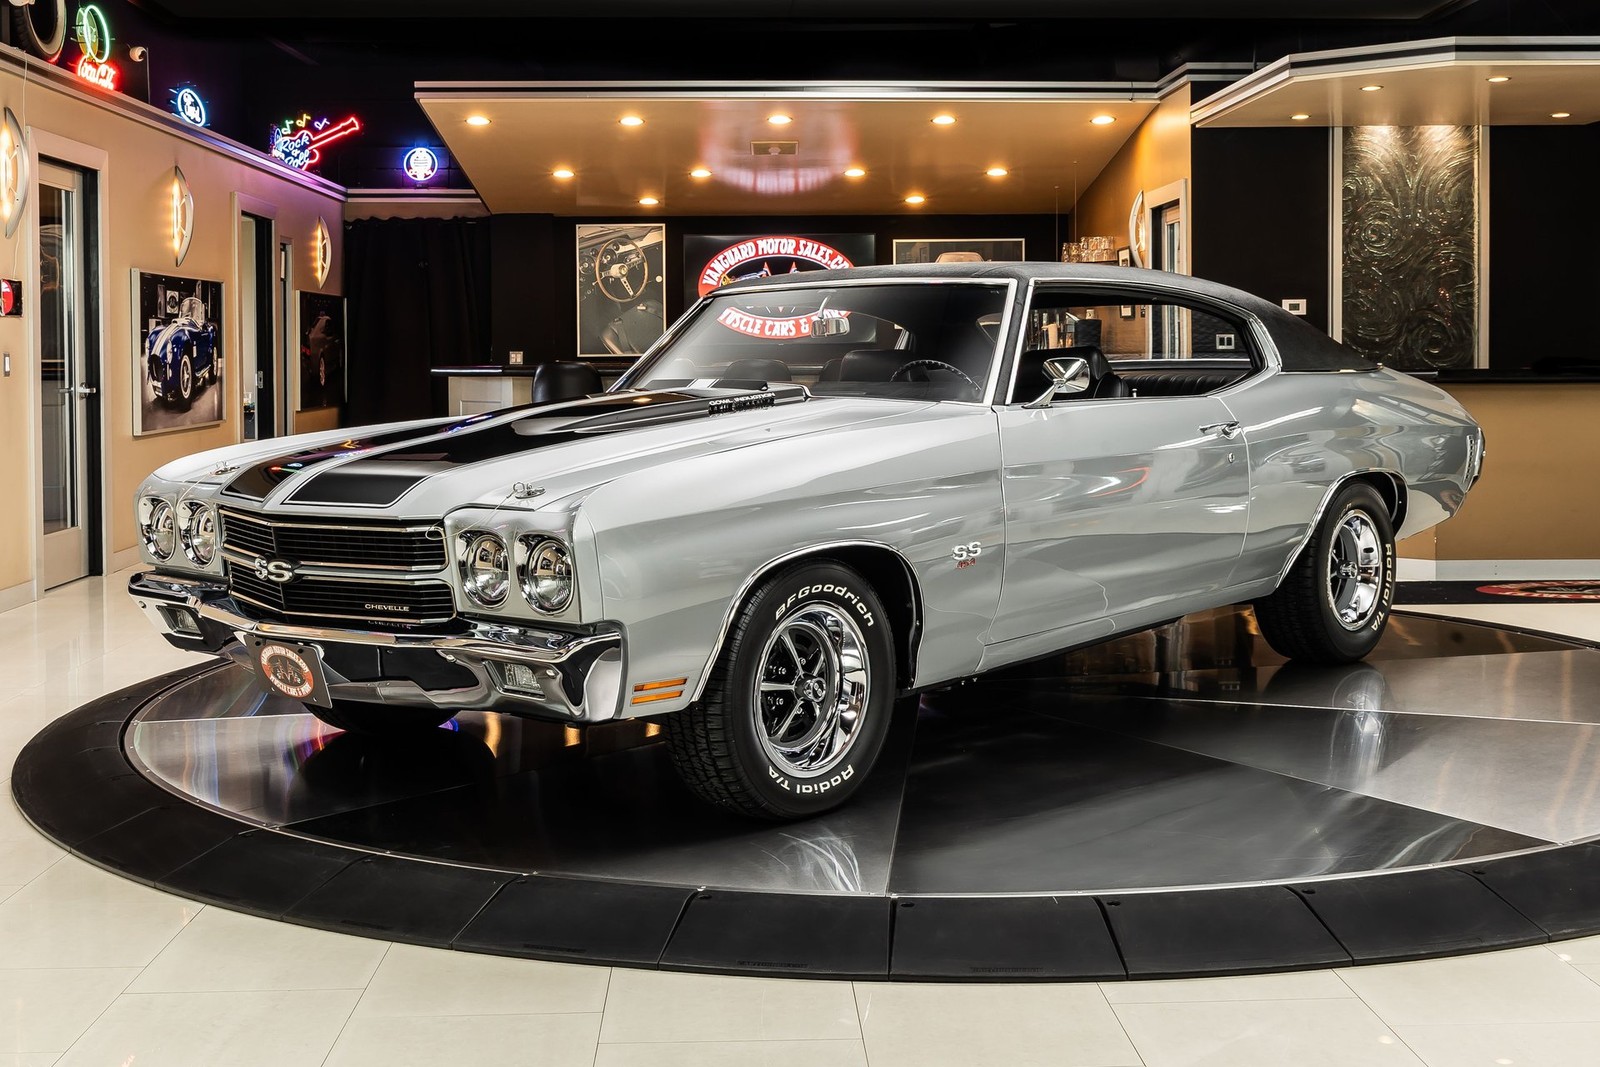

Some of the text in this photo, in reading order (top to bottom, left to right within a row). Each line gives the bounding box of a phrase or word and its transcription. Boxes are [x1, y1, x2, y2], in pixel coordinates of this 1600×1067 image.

[281, 132, 310, 152] Rock
[702, 238, 850, 286] VANGUARD MOTOR SALES.CO
[764, 320, 796, 337] CARS
[799, 318, 809, 333] &
[952, 541, 982, 560] SS
[254, 557, 294, 583] SS
[1371, 543, 1393, 631] Radial T/A
[365, 603, 410, 612] CHEVELLE
[775, 584, 875, 627] BFGoodrich
[768, 764, 855, 794] Radial T/A
